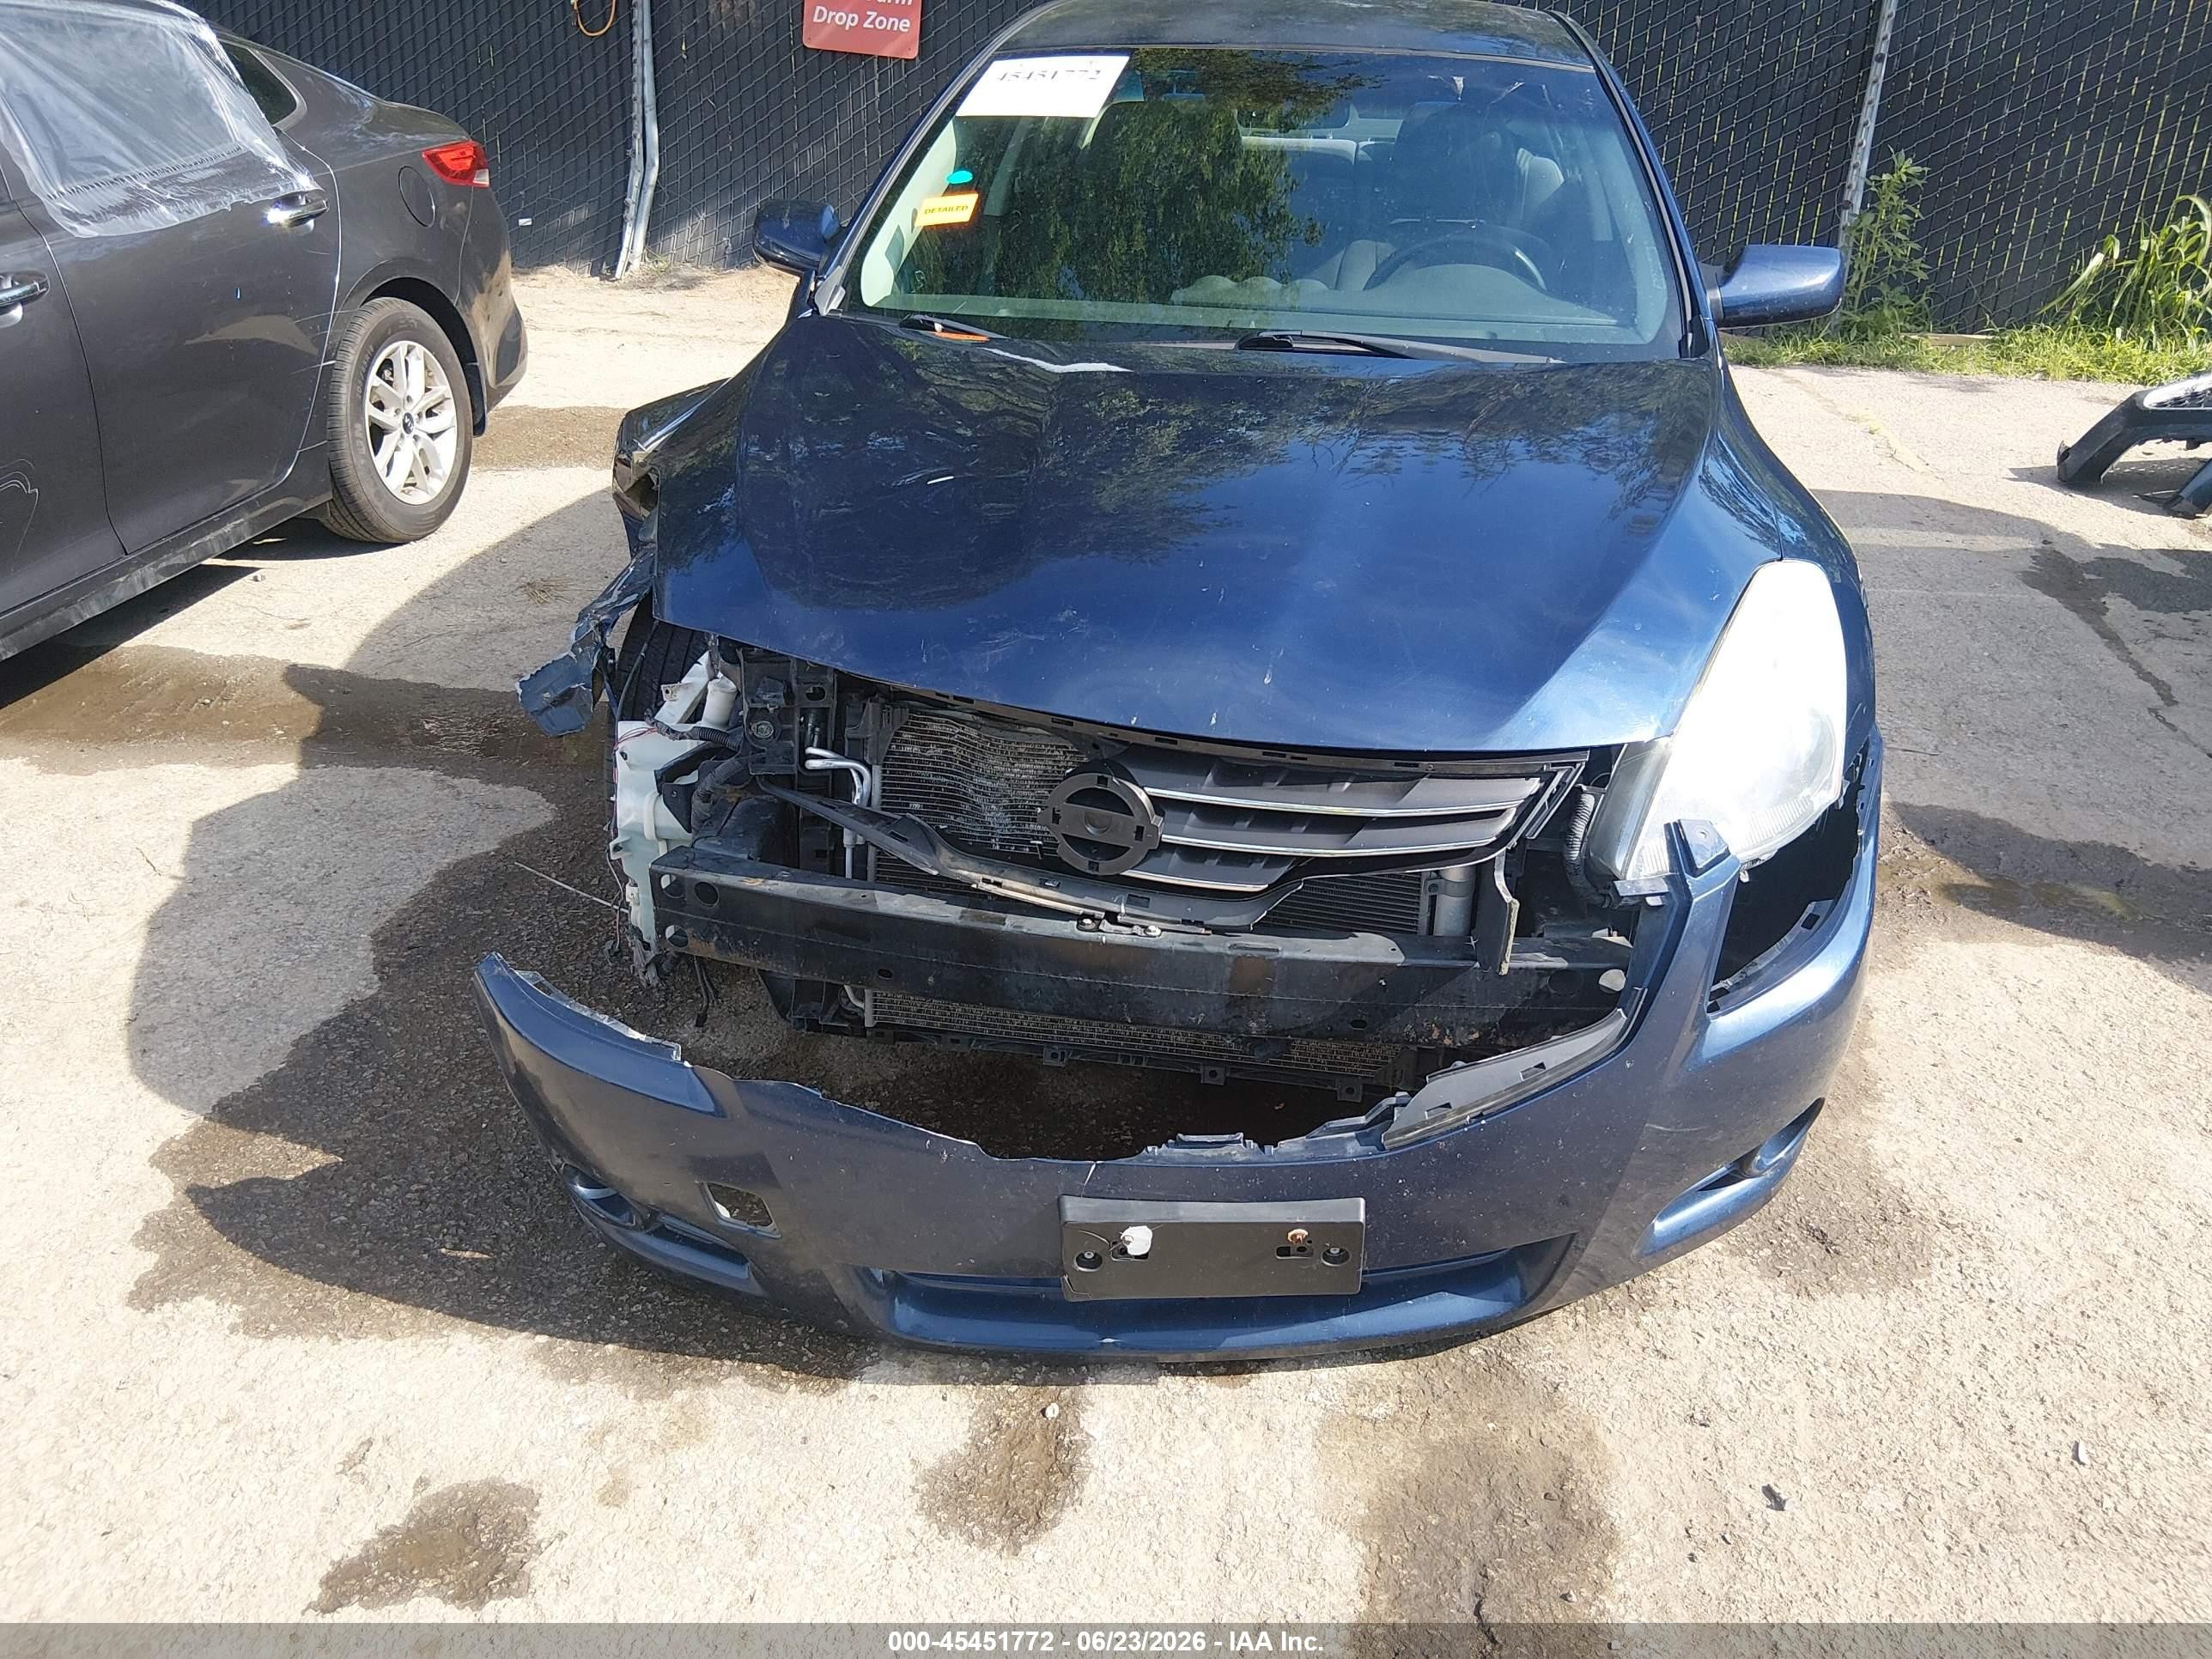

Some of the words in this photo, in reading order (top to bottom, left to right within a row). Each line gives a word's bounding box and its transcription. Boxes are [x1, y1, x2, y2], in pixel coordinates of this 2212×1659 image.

[812, 5, 859, 31] Drop
[863, 10, 911, 32] Zone
[923, 205, 969, 215] DETAILED
